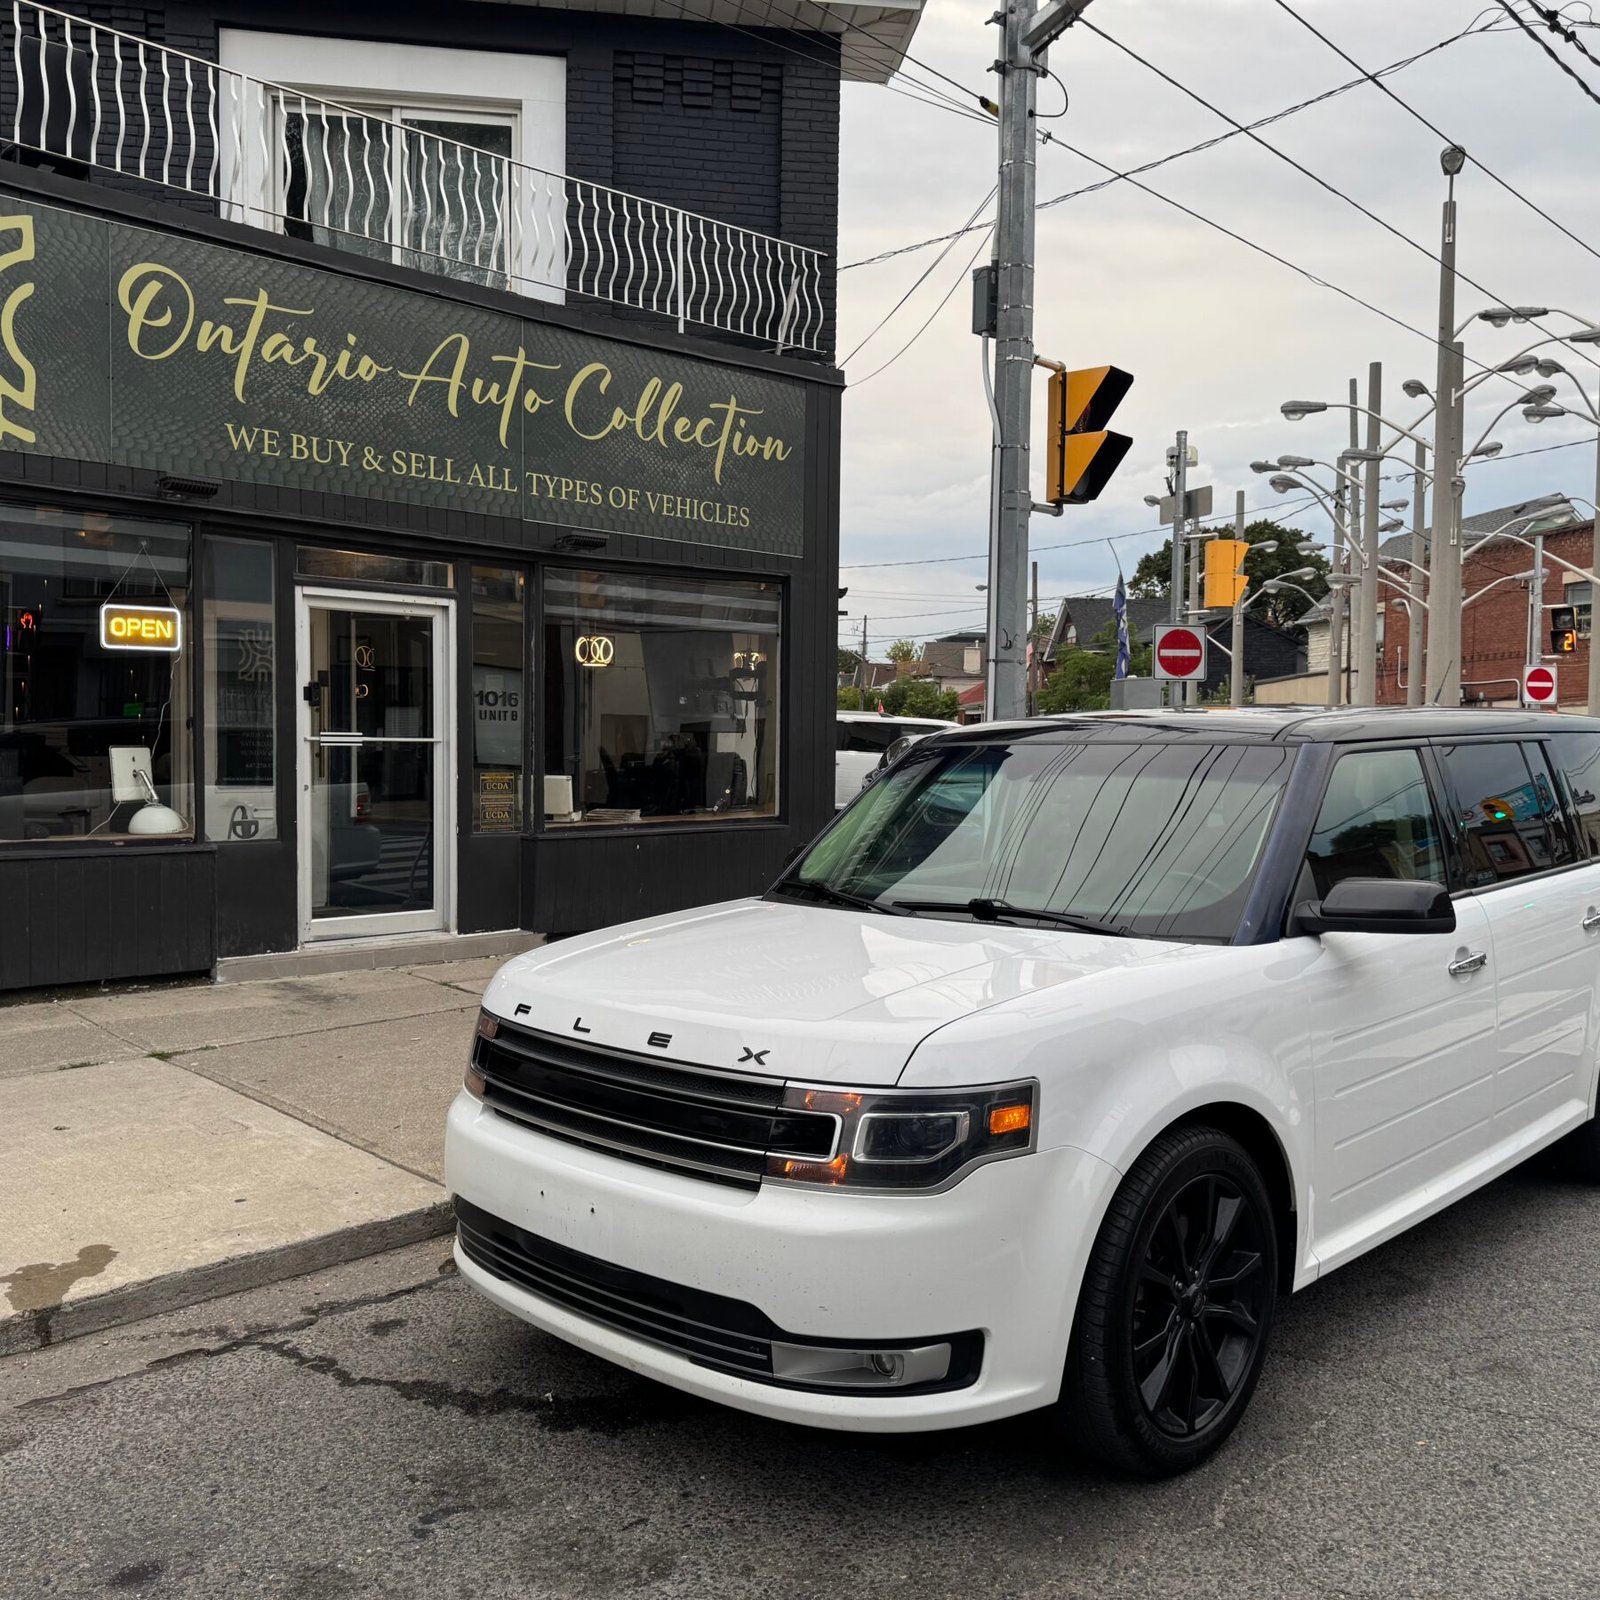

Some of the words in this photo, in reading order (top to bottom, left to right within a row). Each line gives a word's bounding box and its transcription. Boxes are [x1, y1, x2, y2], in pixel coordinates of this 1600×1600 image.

[117, 262, 392, 404] Ontario
[398, 333, 561, 449] Auto
[565, 363, 792, 485] Collection
[224, 422, 281, 457] WE
[291, 434, 355, 467] BUY
[362, 446, 385, 472] &
[392, 451, 461, 484] SELL
[467, 463, 518, 492] ALL
[526, 471, 603, 505] TYPES
[609, 486, 640, 511] OF
[645, 492, 751, 528] VEHICLES
[110, 617, 172, 639] OPEN
[1563, 633, 1573, 651] 2
[475, 690, 519, 708] 1016
[479, 709, 509, 722] UNIT
[486, 782, 509, 790] UCDA
[485, 811, 510, 819] UCDA
[514, 1003, 770, 1065] FLEX
